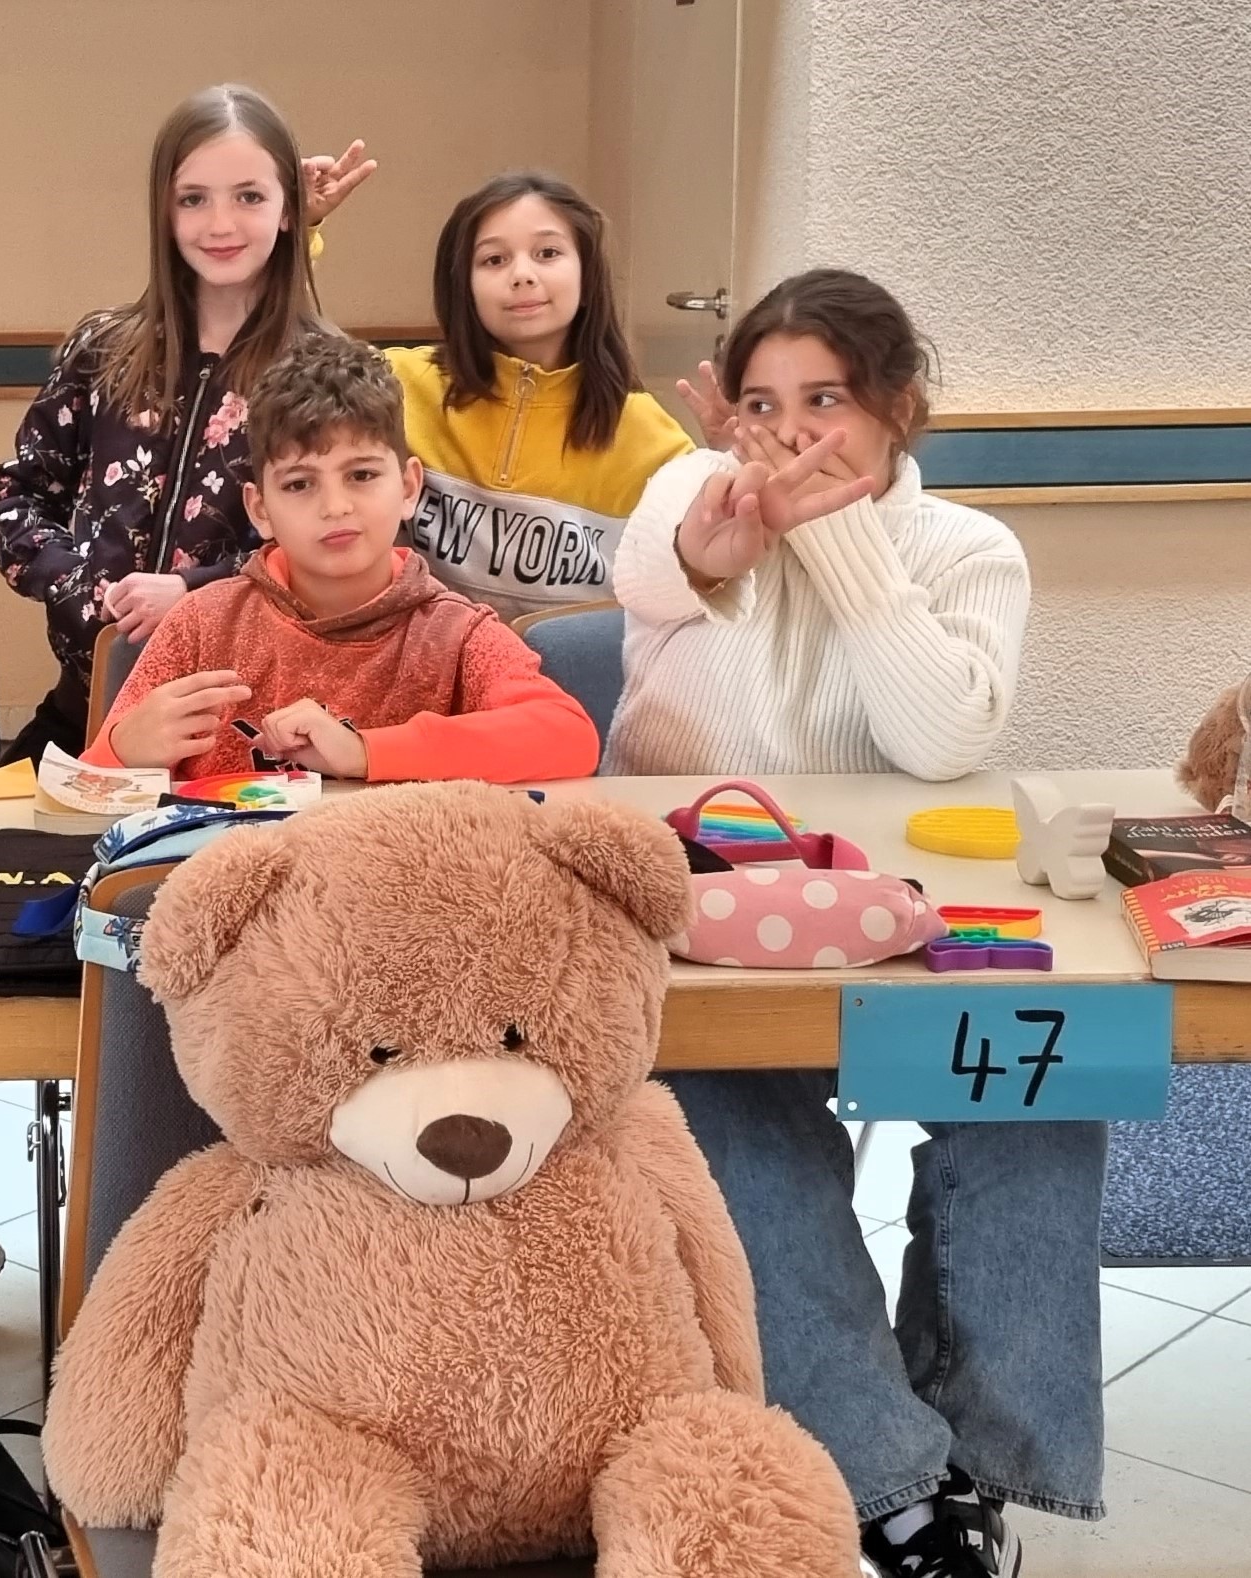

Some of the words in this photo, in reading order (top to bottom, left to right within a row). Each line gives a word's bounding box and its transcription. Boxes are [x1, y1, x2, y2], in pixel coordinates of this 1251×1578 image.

[408, 485, 487, 566] EW
[488, 507, 606, 586] YORK
[951, 1009, 1065, 1107] 47
